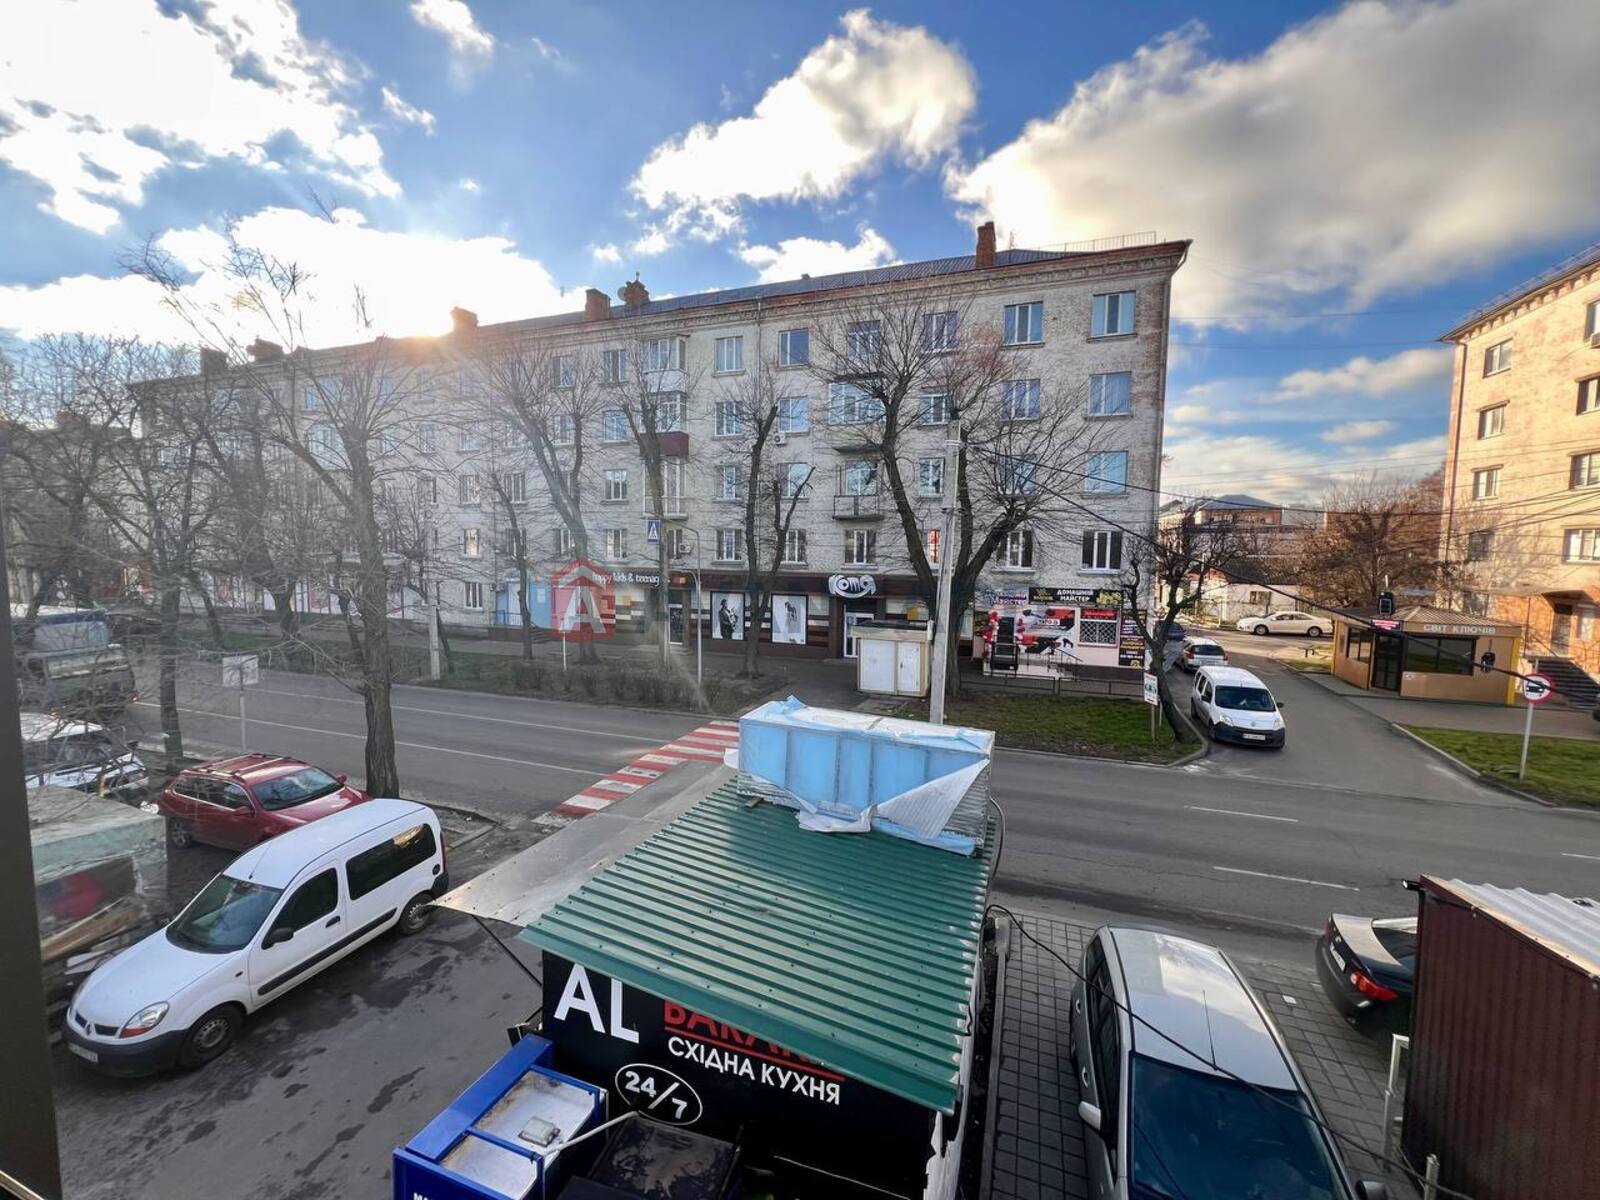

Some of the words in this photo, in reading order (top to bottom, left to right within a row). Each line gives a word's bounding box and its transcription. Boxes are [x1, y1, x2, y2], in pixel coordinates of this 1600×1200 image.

[553, 963, 640, 1044] AL
[624, 1071, 689, 1120] 24/7
[667, 1036, 756, 1081] СХІДНА
[760, 1063, 841, 1105] КУХНЯ
